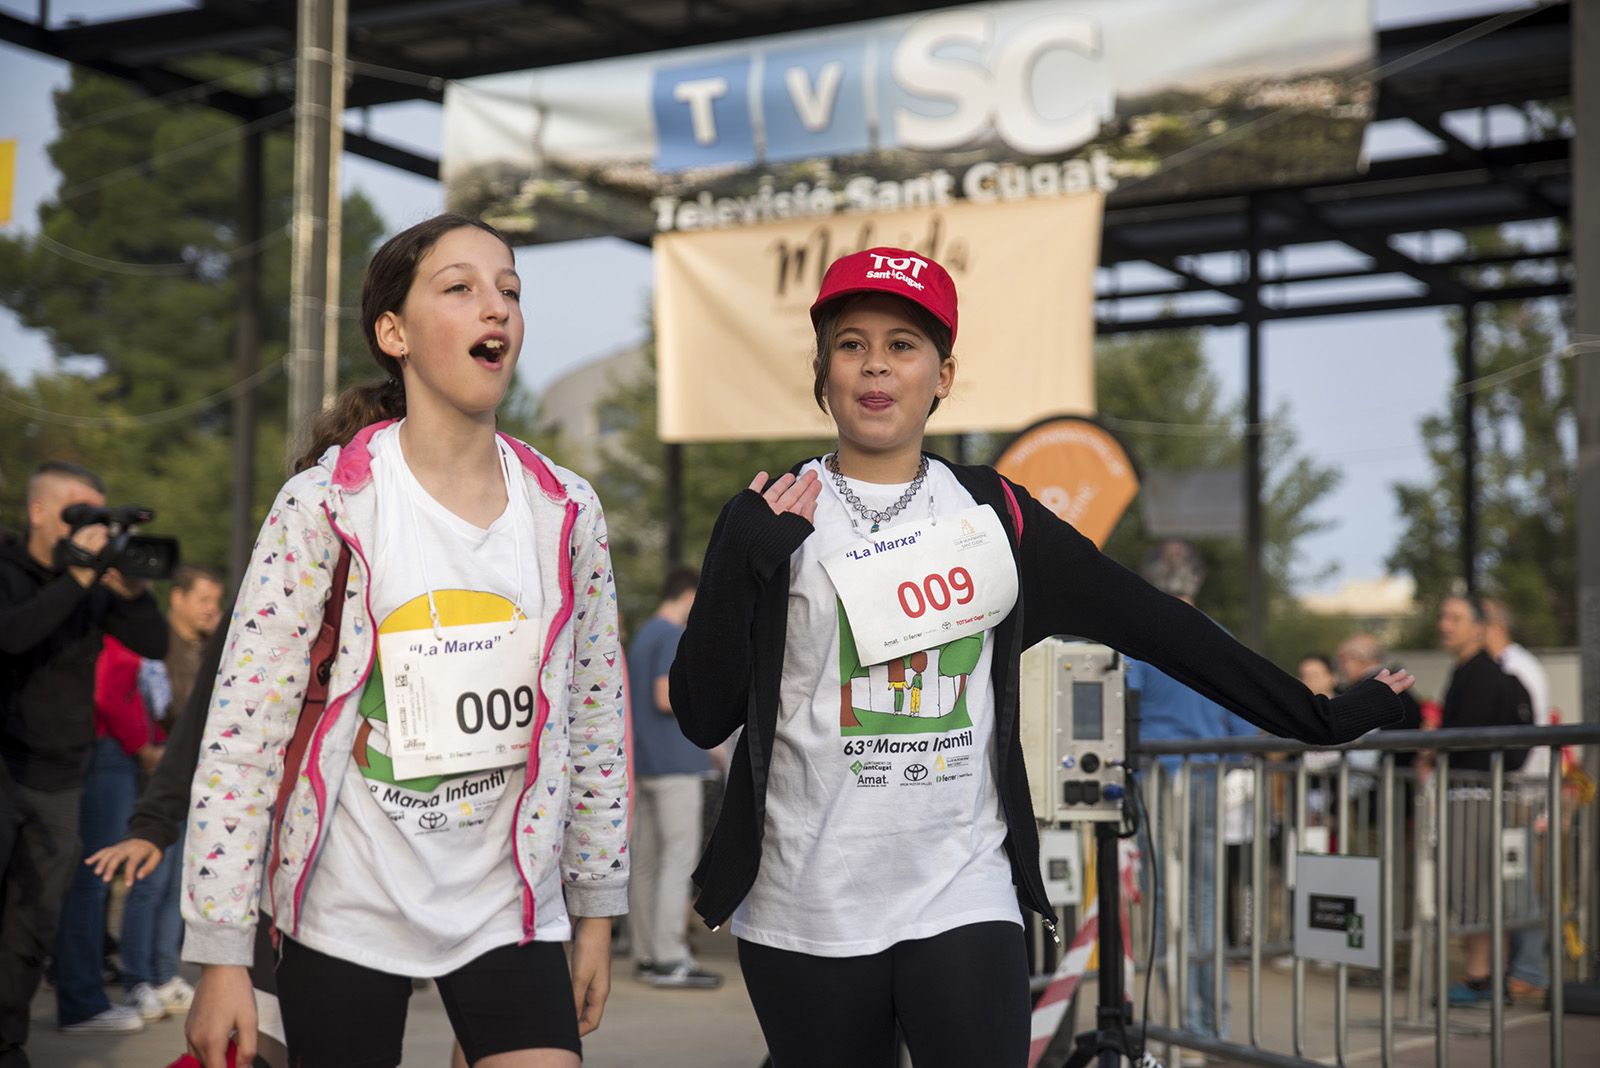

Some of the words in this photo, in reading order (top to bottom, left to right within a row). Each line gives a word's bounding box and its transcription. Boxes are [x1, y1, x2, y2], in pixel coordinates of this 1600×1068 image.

[845, 168, 955, 213] Sant
[962, 150, 1118, 203] Cugat
[869, 253, 928, 279] TOT
[897, 566, 975, 619] 009
[456, 685, 535, 735] 009
[873, 738, 929, 754] Marxa
[383, 788, 440, 809] Marxa
[446, 769, 505, 803] Infantil
